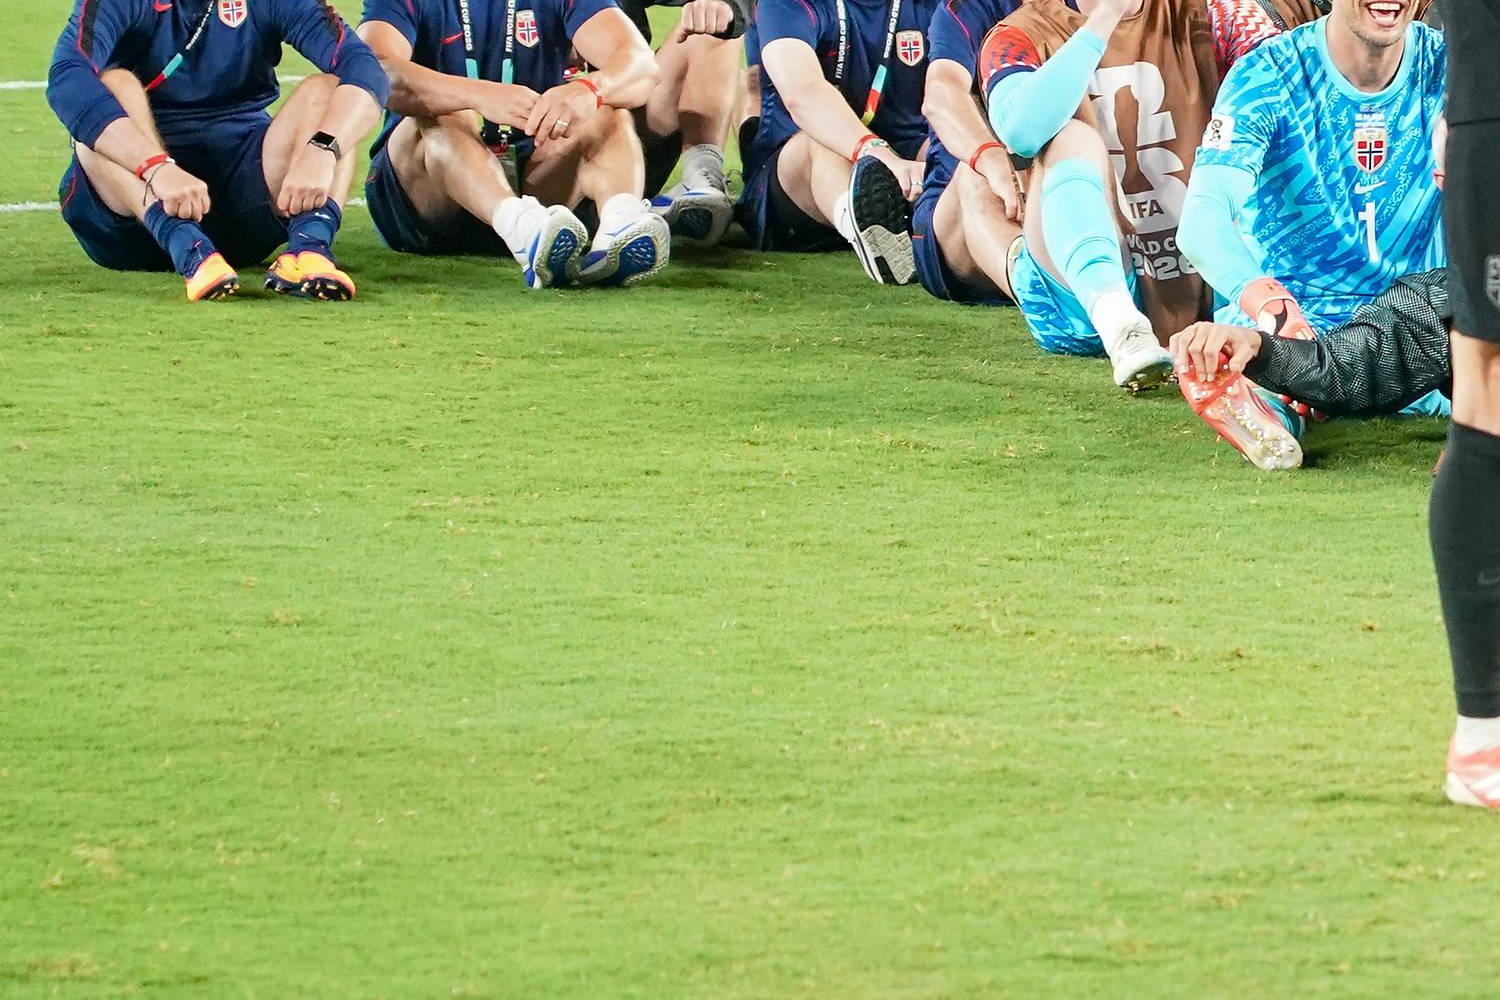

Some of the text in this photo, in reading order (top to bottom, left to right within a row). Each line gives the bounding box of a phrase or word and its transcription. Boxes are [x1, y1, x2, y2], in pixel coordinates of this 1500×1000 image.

[506, 8, 515, 35] WORLD
[888, 17, 897, 33] CUP
[505, 35, 513, 52] FIFA
[837, 36, 846, 62] WORLD
[835, 62, 843, 78] FIFA
[1358, 202, 1379, 264] 1
